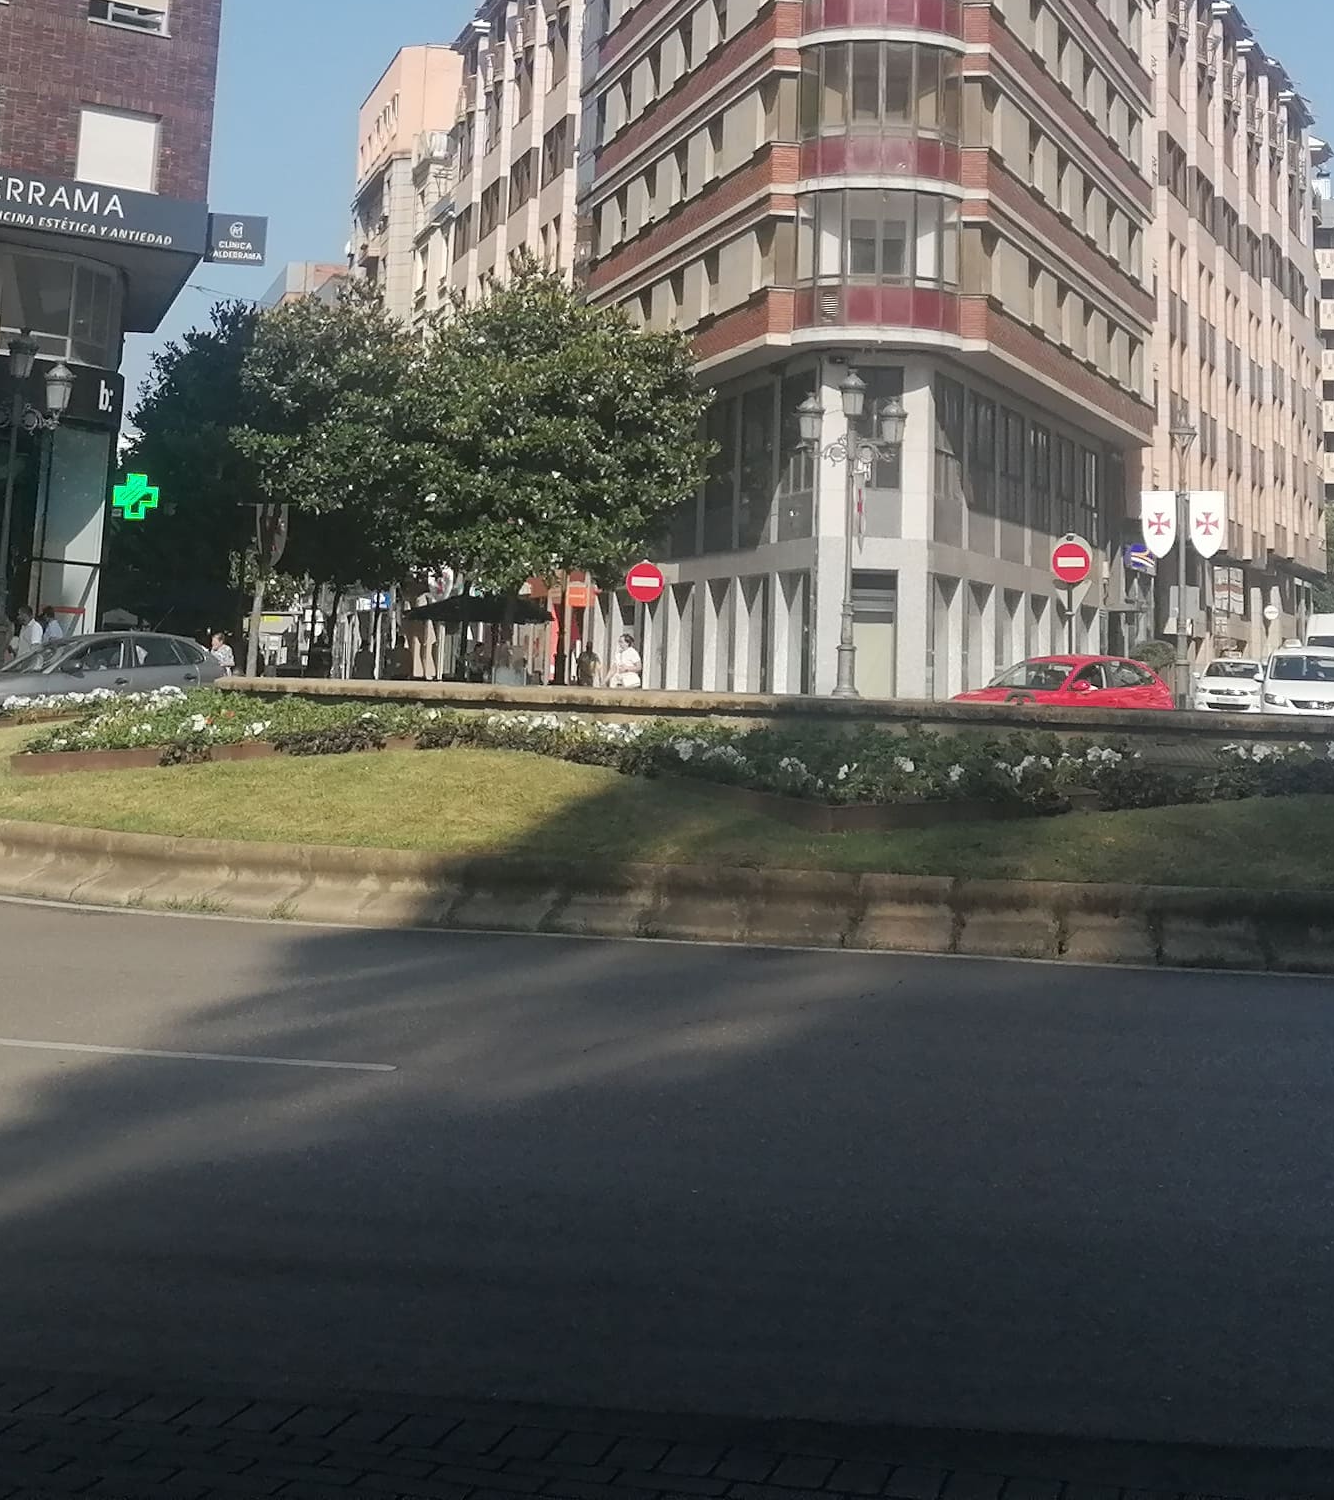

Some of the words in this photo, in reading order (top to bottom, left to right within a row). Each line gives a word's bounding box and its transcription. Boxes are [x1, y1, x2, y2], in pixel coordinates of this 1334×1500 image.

[38, 215, 97, 236] ESTÉTICA
[100, 225, 110, 238] Y
[109, 227, 173, 246] ANTIEDAD
[218, 240, 253, 250] CLINICA
[98, 379, 114, 413] b:
